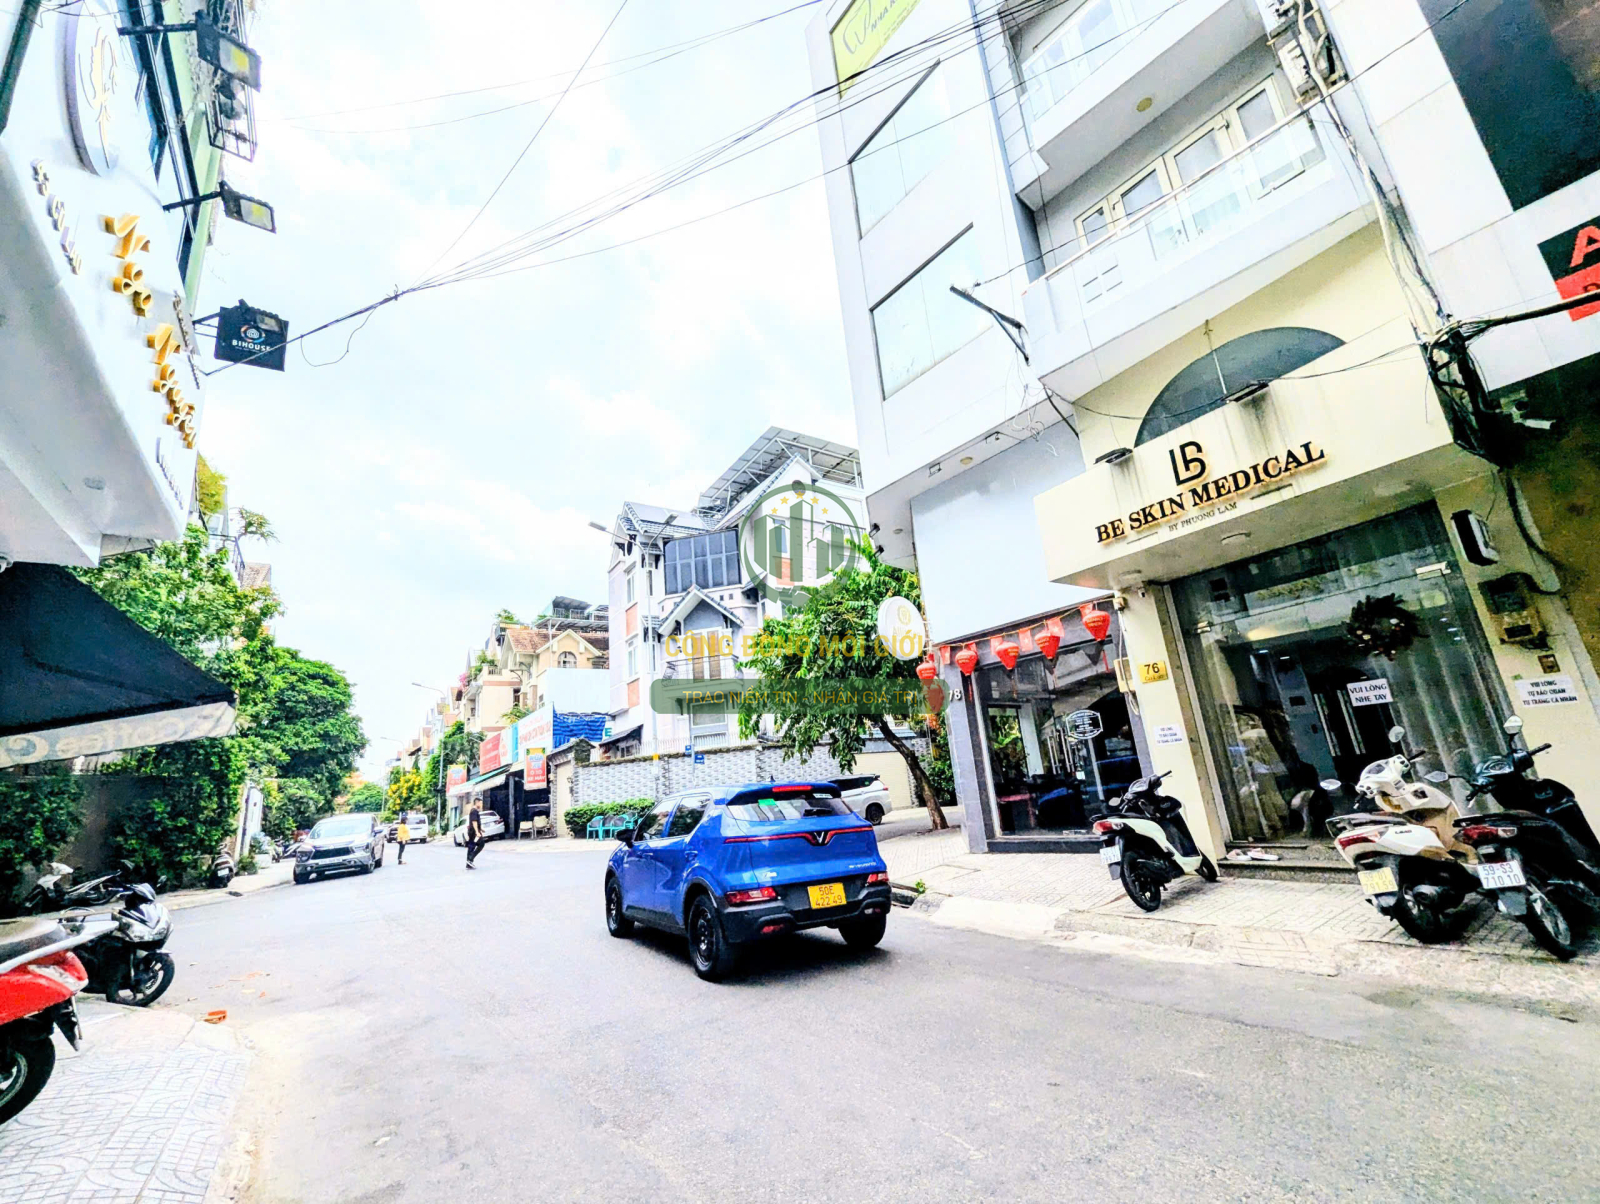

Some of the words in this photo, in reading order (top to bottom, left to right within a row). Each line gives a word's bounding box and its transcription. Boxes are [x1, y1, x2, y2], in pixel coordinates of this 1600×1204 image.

[1095, 519, 1126, 543] BE
[1128, 493, 1185, 530] SKIN
[1188, 441, 1326, 508] MEDICAL
[1168, 522, 1179, 532] BY
[1144, 662, 1160, 675] 76
[1365, 683, 1387, 692] LÒNG
[1483, 862, 1514, 876] 59-S3
[1484, 873, 1521, 888] 710.10
[819, 885, 835, 896] 50E
